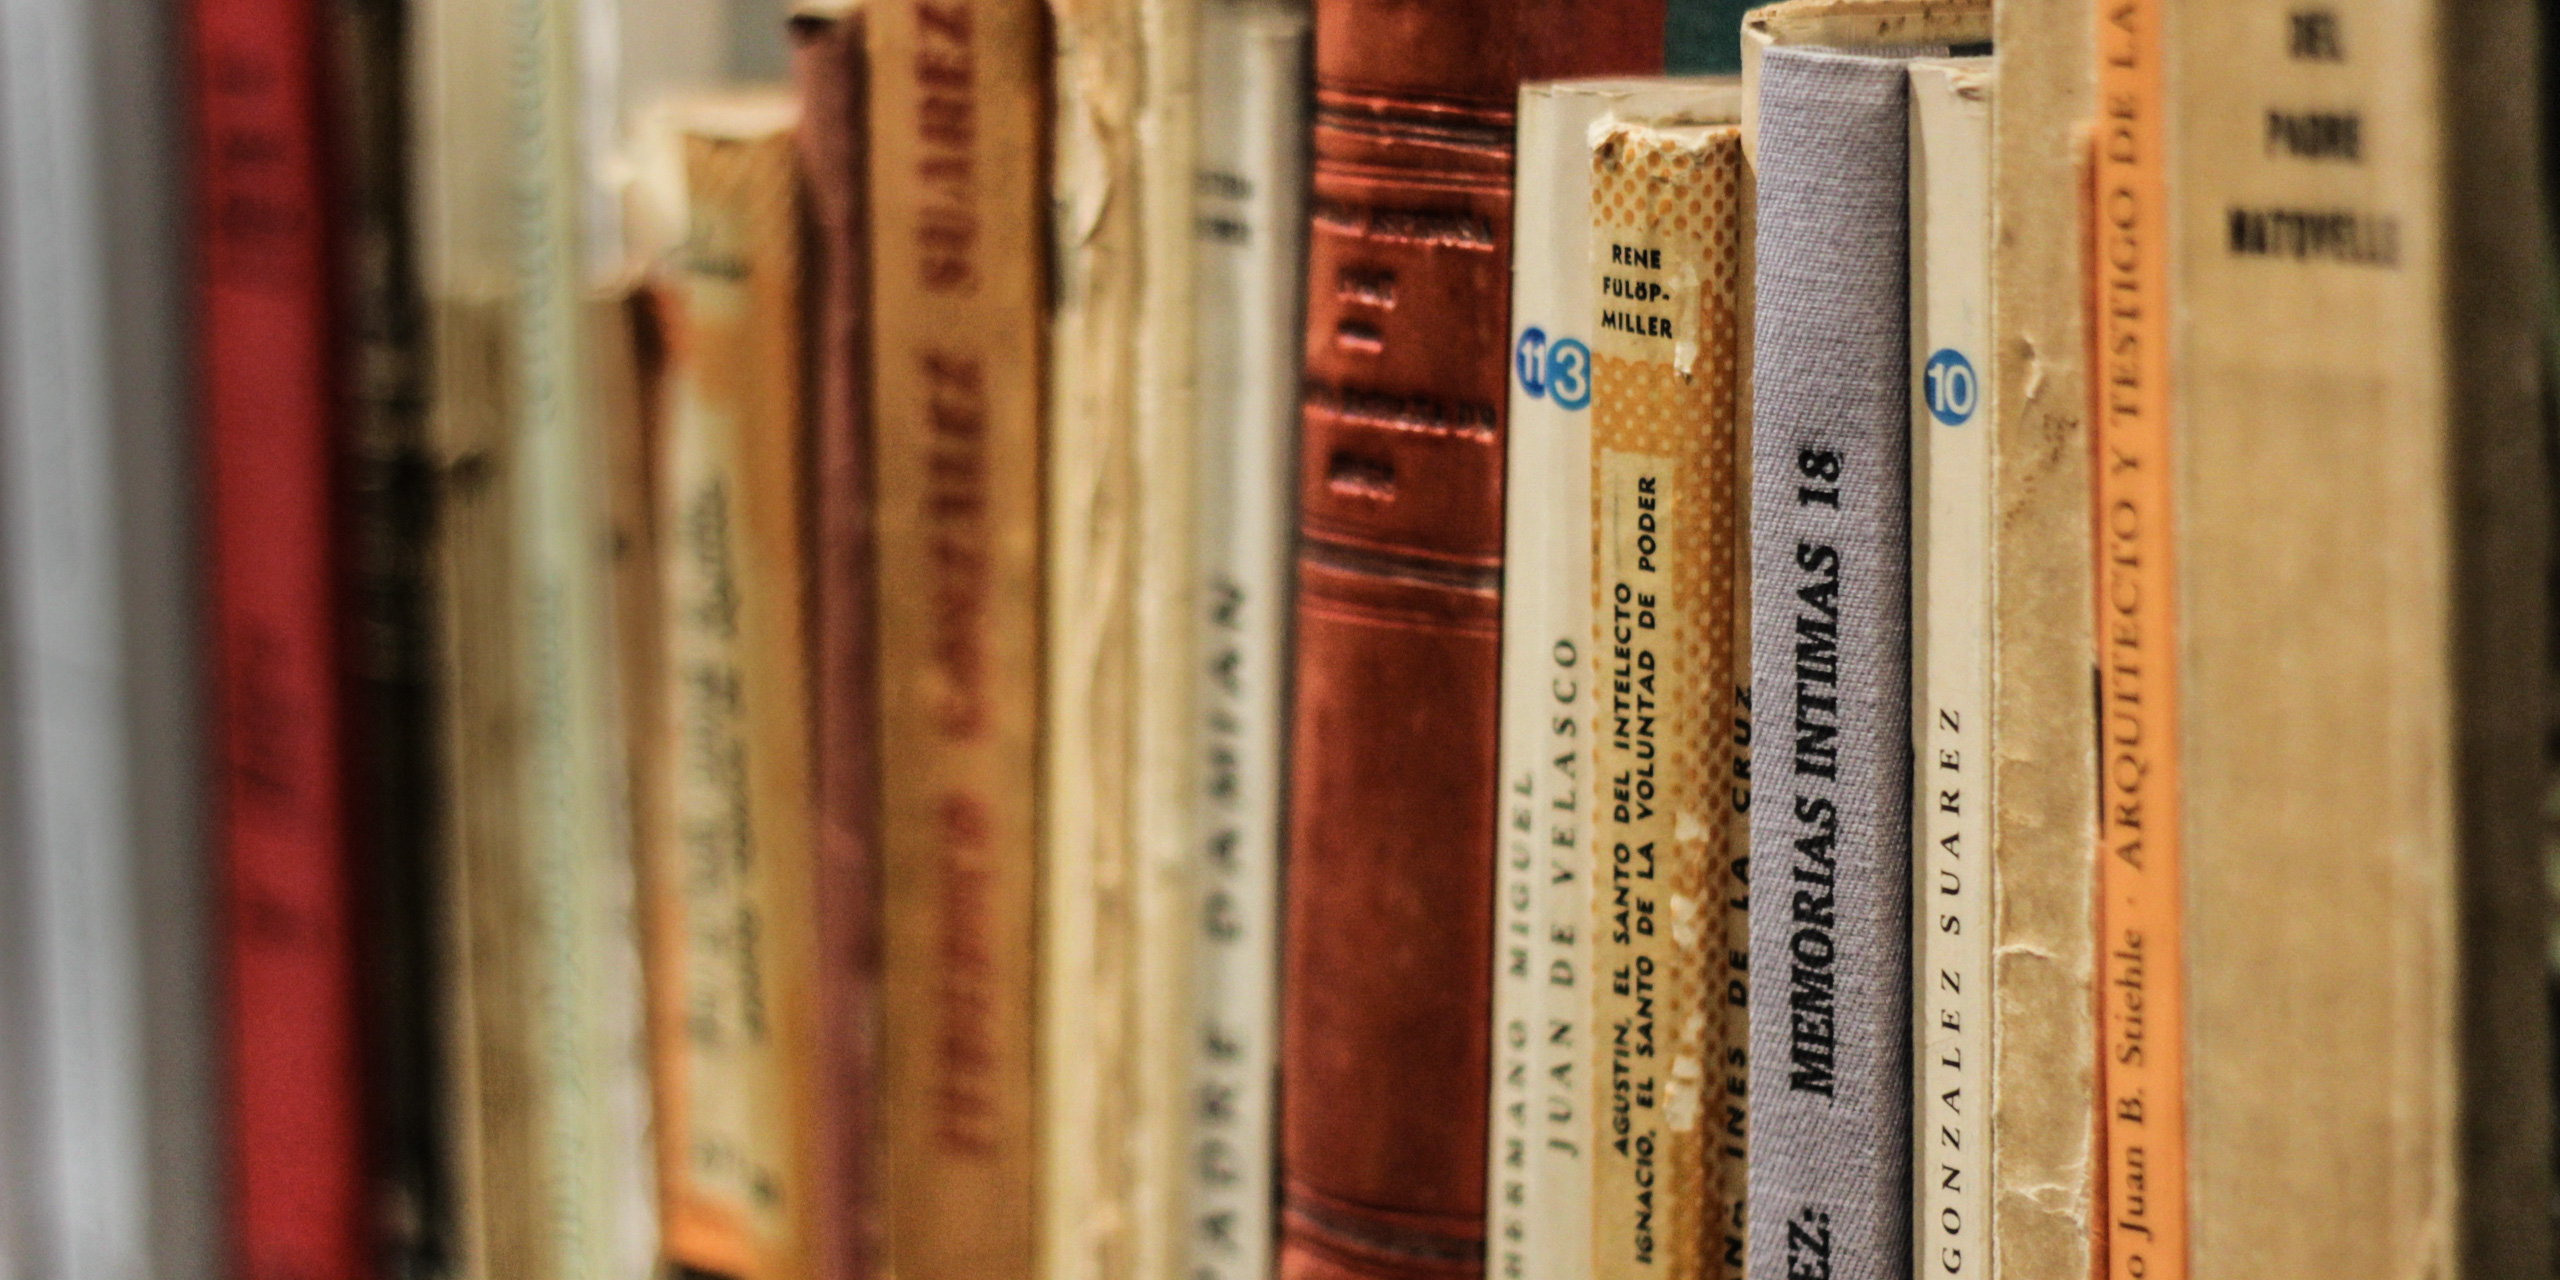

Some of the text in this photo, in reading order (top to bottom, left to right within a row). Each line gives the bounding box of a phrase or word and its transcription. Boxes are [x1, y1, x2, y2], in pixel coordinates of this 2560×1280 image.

[2107, 98, 2138, 167] DE
[1612, 243, 1661, 270] RENE
[1601, 309, 1673, 339] MILLER
[2108, 184, 2140, 428] TESTIGO
[2110, 447, 2139, 476] Y
[1637, 476, 1657, 573] PODER
[1637, 592, 1656, 630] DE
[2110, 500, 2149, 873] ARQUITECTO
[1637, 650, 1656, 822] VOLUNTAD
[1732, 685, 1751, 813] CRUZ
[1789, 449, 1842, 1100] MEMORIAS INTIMAS 18
[1547, 635, 1580, 1159] JUAN DE VELASCO
[1612, 582, 1632, 1158] AGUSTIN, EL SANTO DEL INTELECTO
[1636, 842, 1655, 881] LA
[1730, 856, 1750, 911] LA
[1636, 897, 1655, 938] DE
[1504, 772, 1534, 1280] HERMANO MIGUEL
[1636, 955, 1655, 1058] SANTO
[1728, 949, 1749, 1008] DE
[1939, 707, 1963, 1277] GONZALEZ SUAREZ
[2113, 927, 2146, 1068] Stiehle
[1636, 1076, 1654, 1109] EL
[1726, 1046, 1747, 1159] INES
[2116, 1087, 2147, 1127] B.
[2118, 1146, 2152, 1244] Juan
